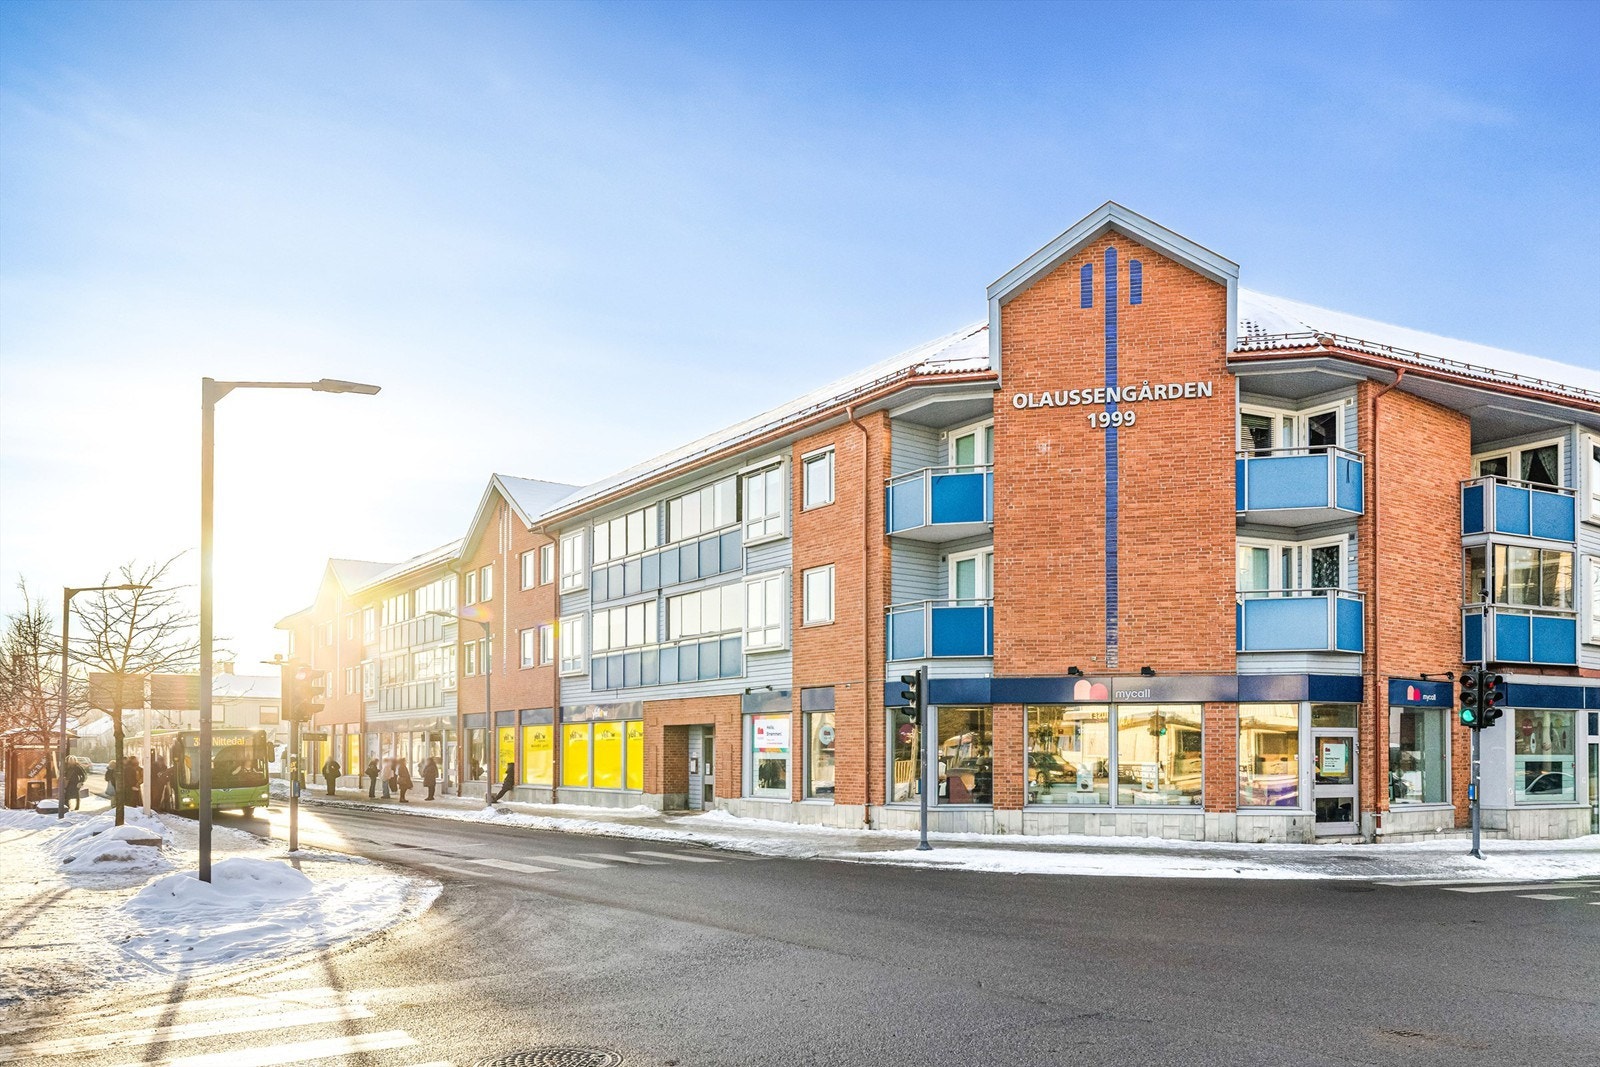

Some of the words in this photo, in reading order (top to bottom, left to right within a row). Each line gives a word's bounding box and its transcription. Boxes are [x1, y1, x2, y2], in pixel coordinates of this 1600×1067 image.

[1012, 380, 1213, 409] OLAUSSENGÅRDEN
[1087, 411, 1136, 428] 1999
[1115, 689, 1151, 700] mycall
[212, 736, 245, 746] Nittedal
